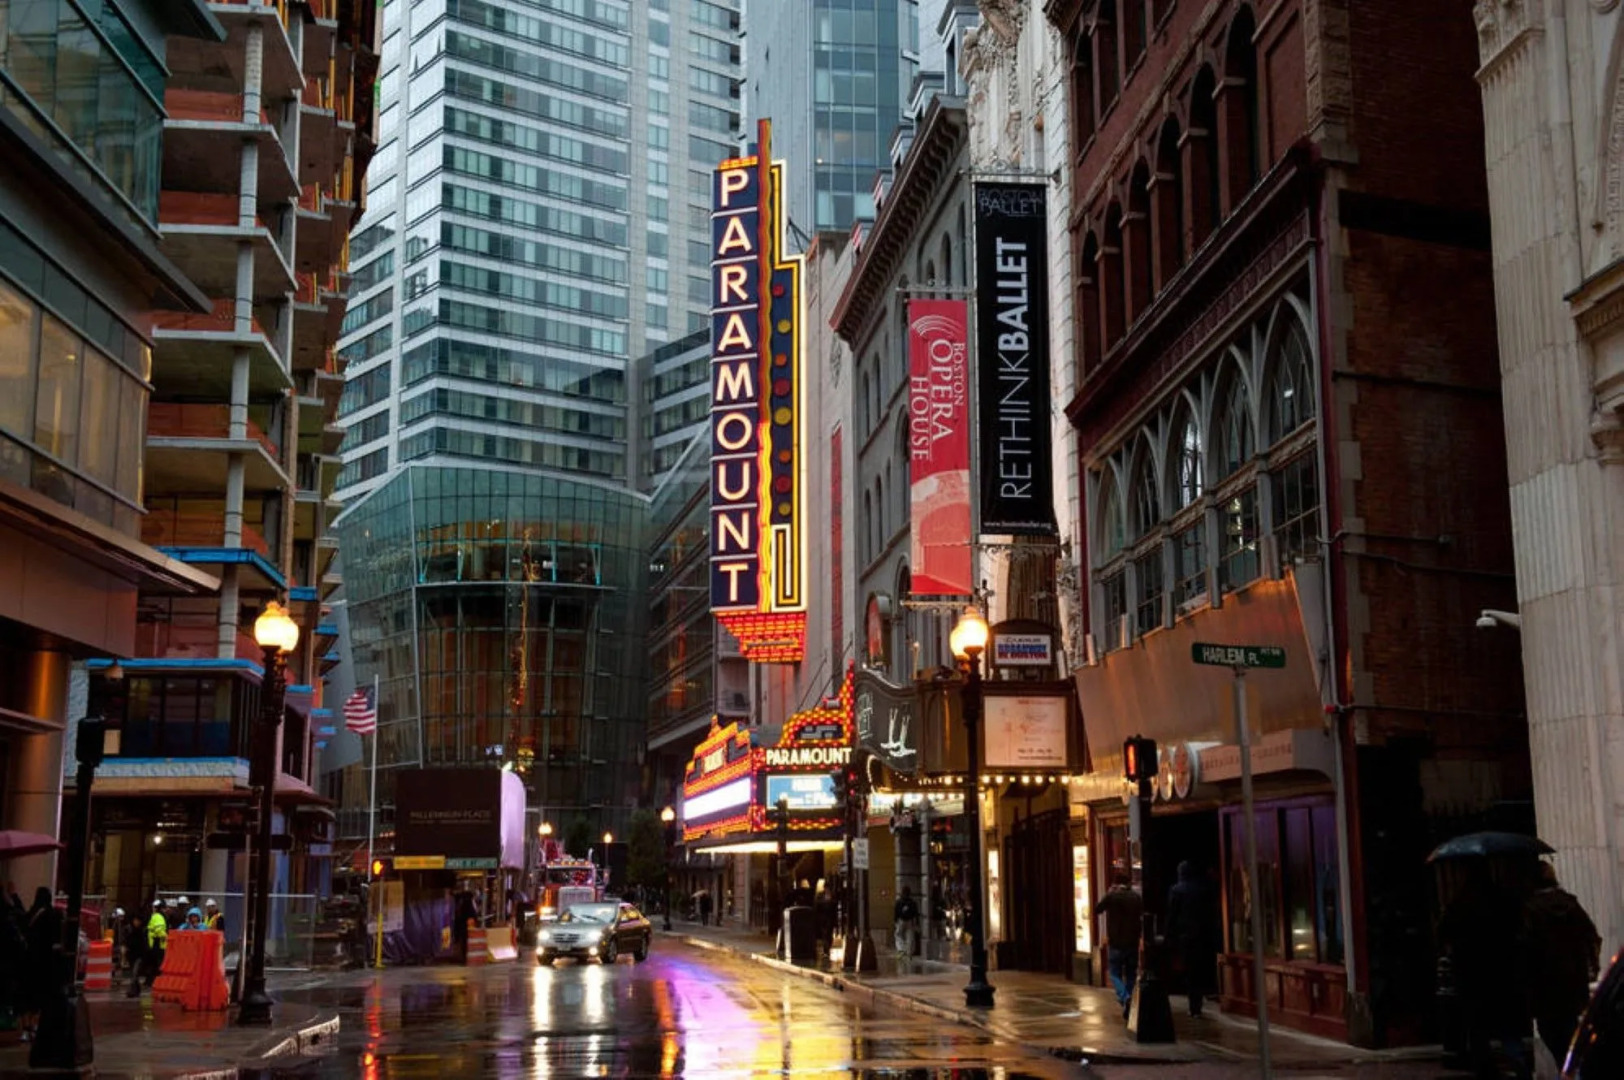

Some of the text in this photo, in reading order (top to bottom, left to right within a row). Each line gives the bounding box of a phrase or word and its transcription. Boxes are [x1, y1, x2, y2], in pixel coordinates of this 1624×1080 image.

[715, 168, 753, 602] PARAMOUNT
[930, 338, 954, 441] OPERA
[952, 342, 966, 406] BOSTON
[911, 376, 930, 461] HOUSE
[1202, 646, 1246, 665] HARLEM
[766, 748, 853, 766] PARAMOUNT
